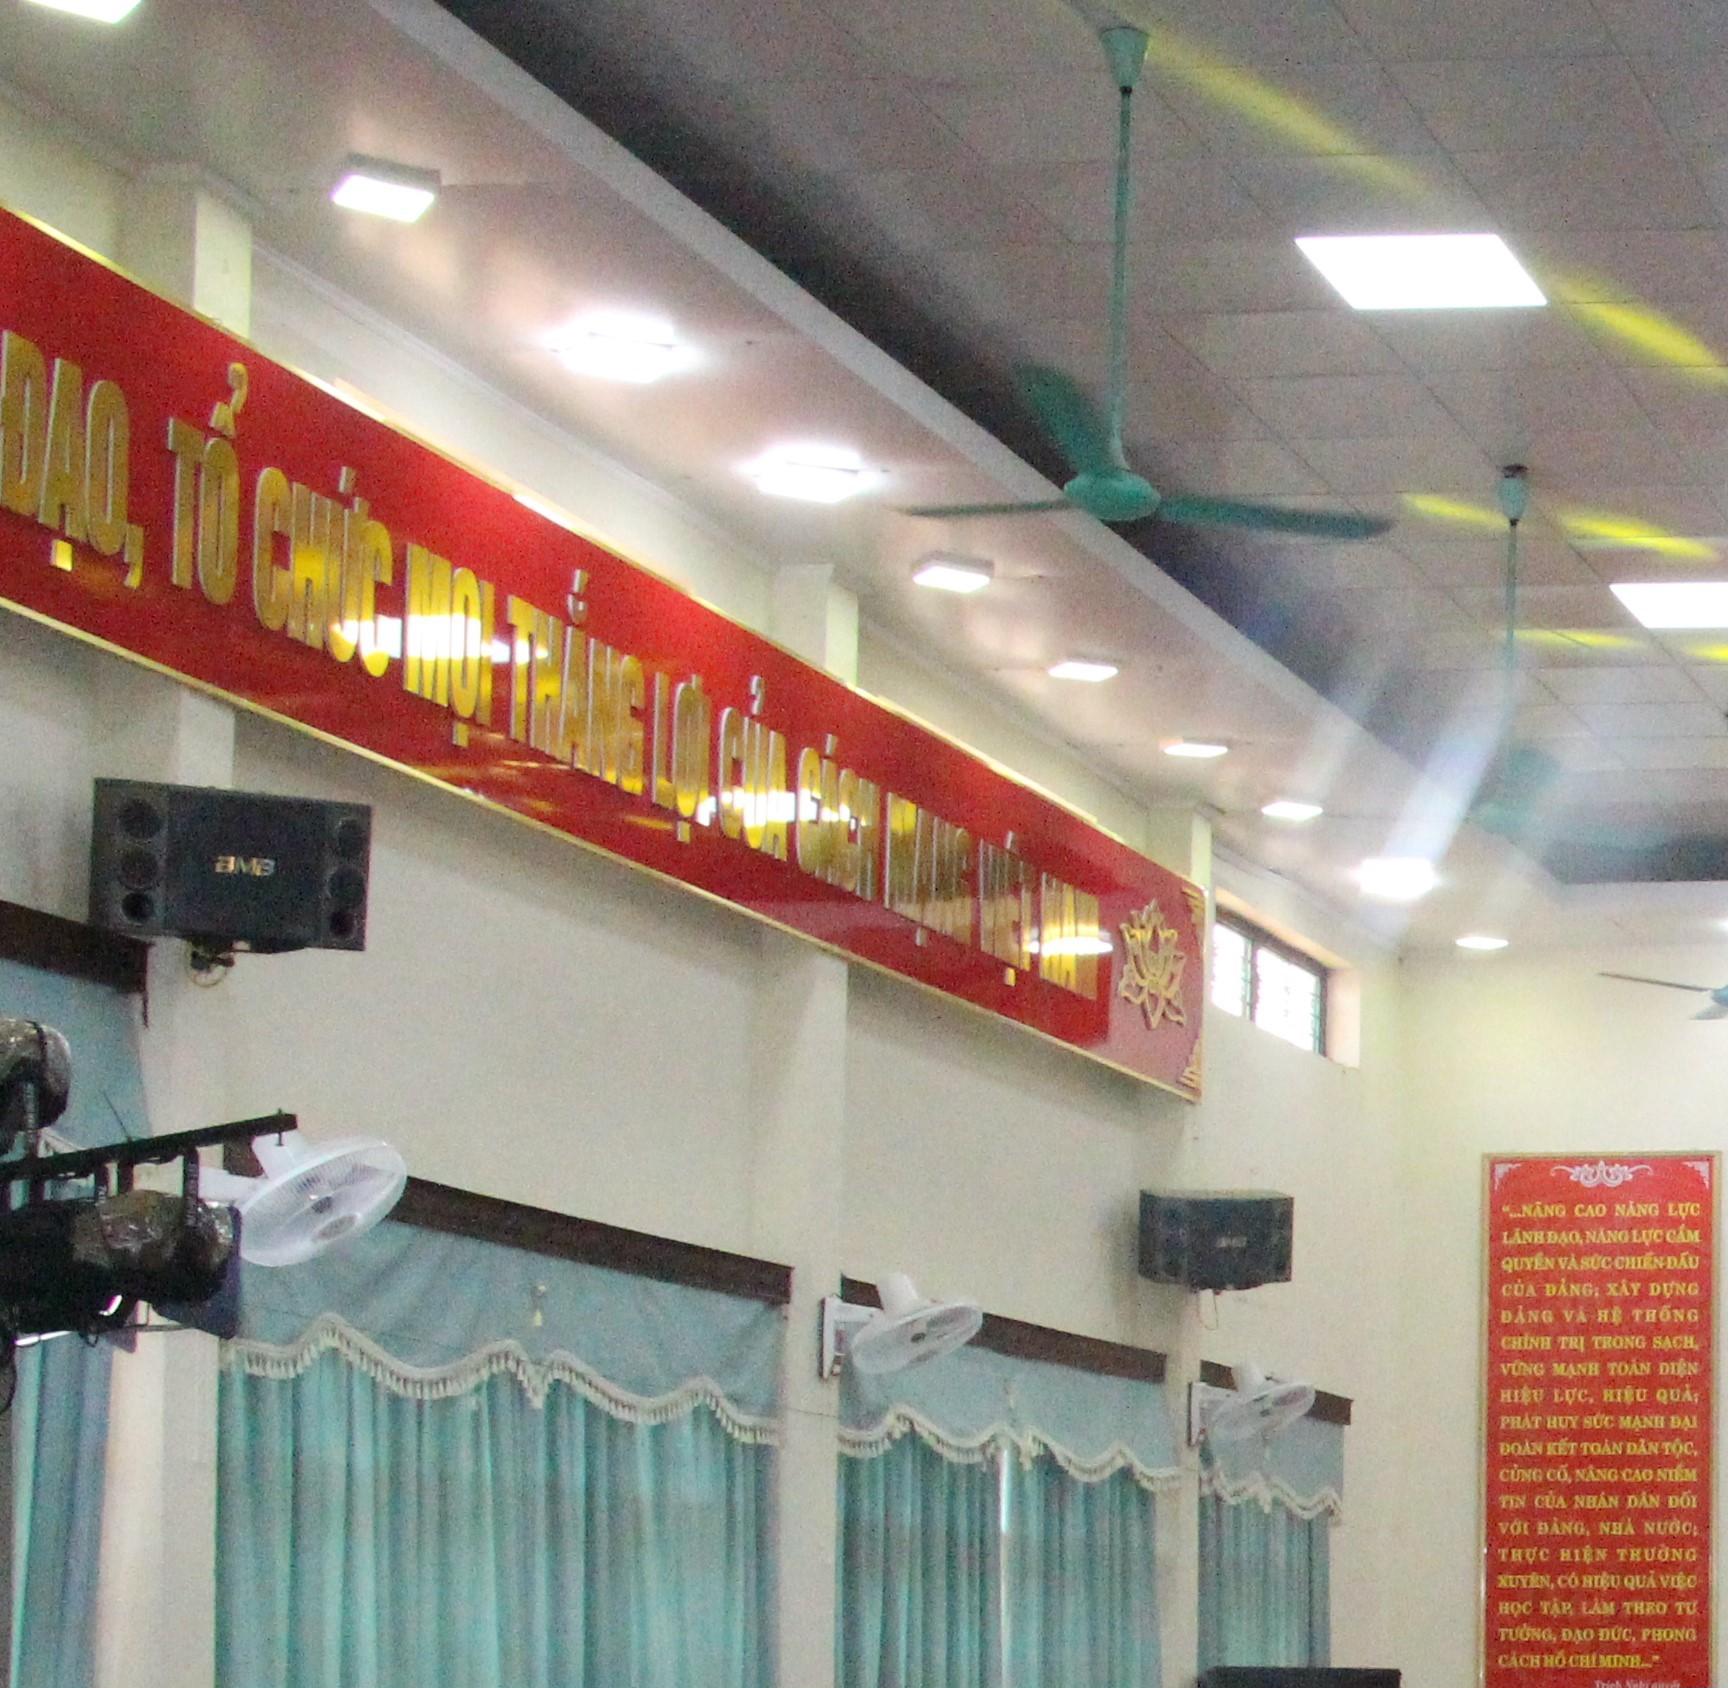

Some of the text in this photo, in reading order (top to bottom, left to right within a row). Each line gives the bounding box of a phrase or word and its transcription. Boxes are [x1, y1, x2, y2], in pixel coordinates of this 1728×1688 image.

[167, 362, 248, 605] TỔ
[254, 466, 393, 677] CHỨC
[404, 543, 494, 747] MỌI
[508, 569, 643, 795] THẮNG
[652, 672, 717, 843] LỢI
[719, 675, 787, 861] CỦA
[797, 733, 880, 901] CÁCH
